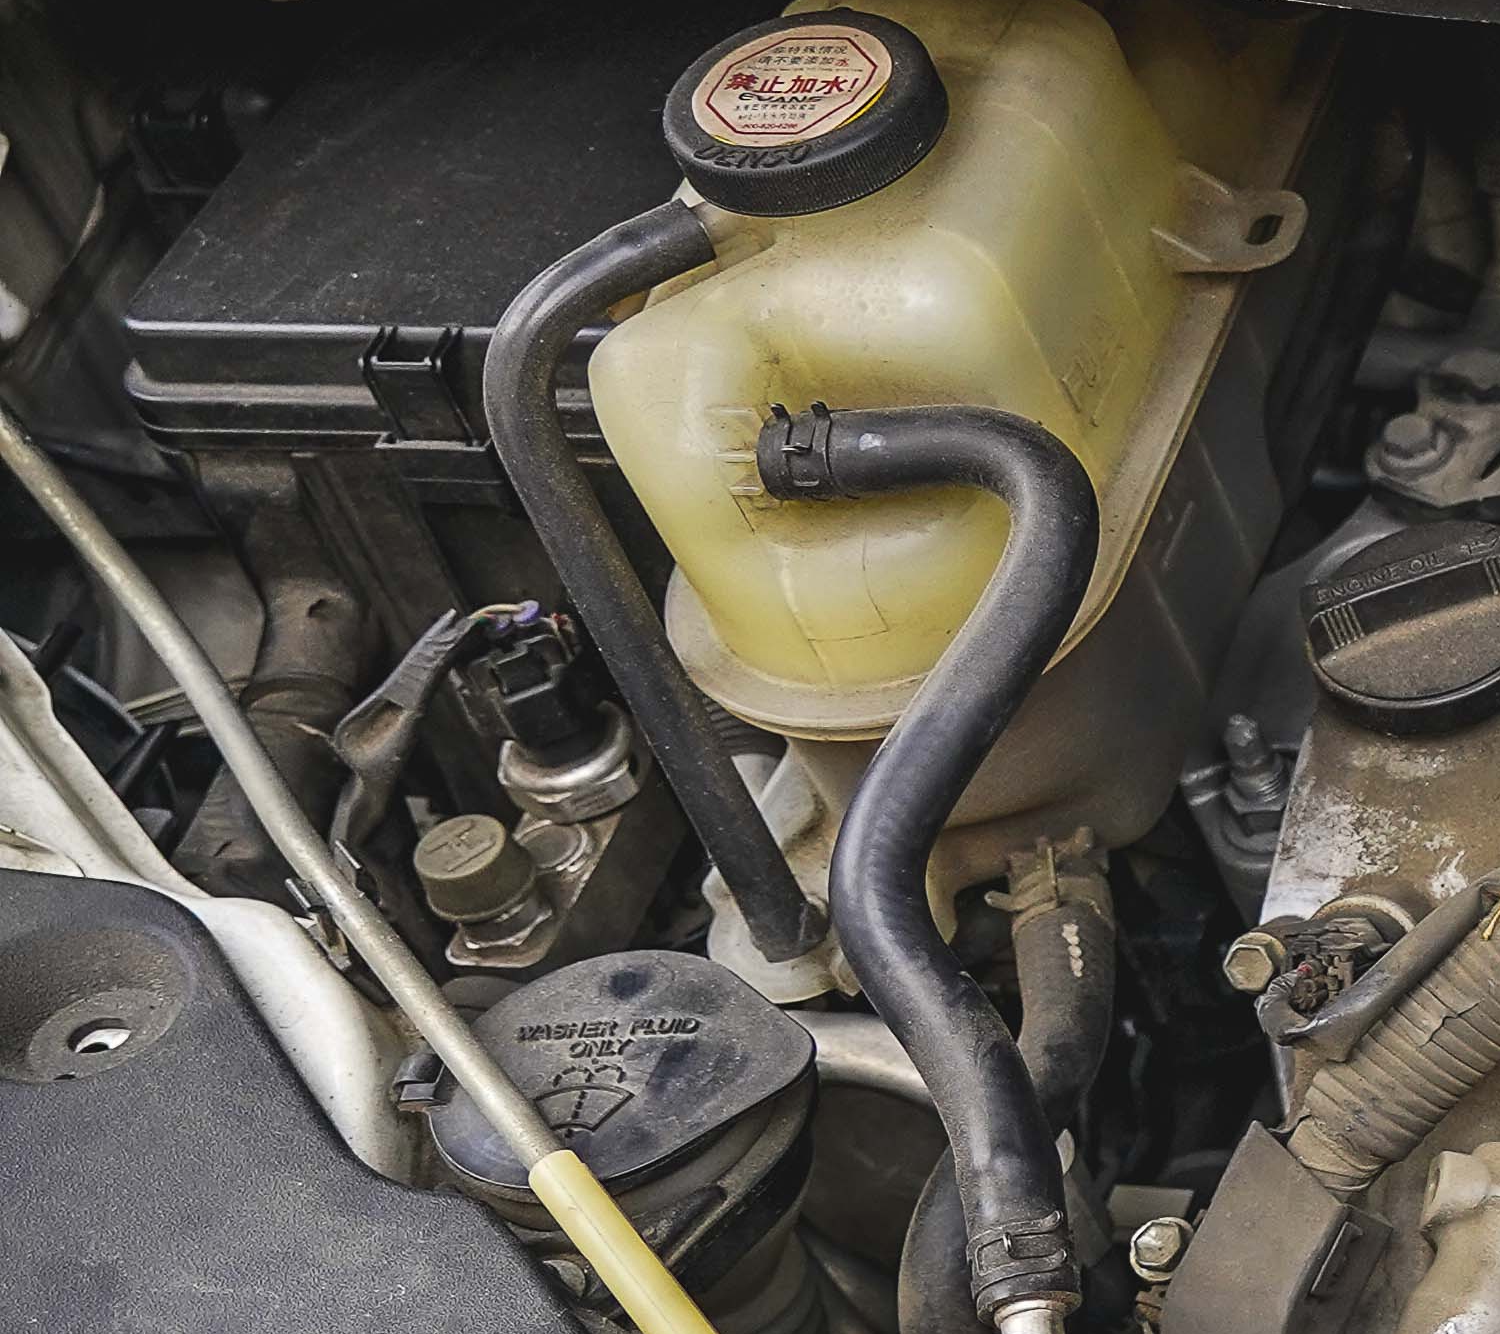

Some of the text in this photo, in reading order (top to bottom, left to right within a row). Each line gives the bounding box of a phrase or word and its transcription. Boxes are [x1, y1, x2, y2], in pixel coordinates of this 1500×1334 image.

[724, 72, 859, 95] 禁止加水!
[694, 146, 812, 170] DENSO
[1316, 553, 1447, 605] ENGINE OIL
[518, 1017, 701, 1041] WASHER FLUID
[569, 1039, 635, 1058] ONLY
